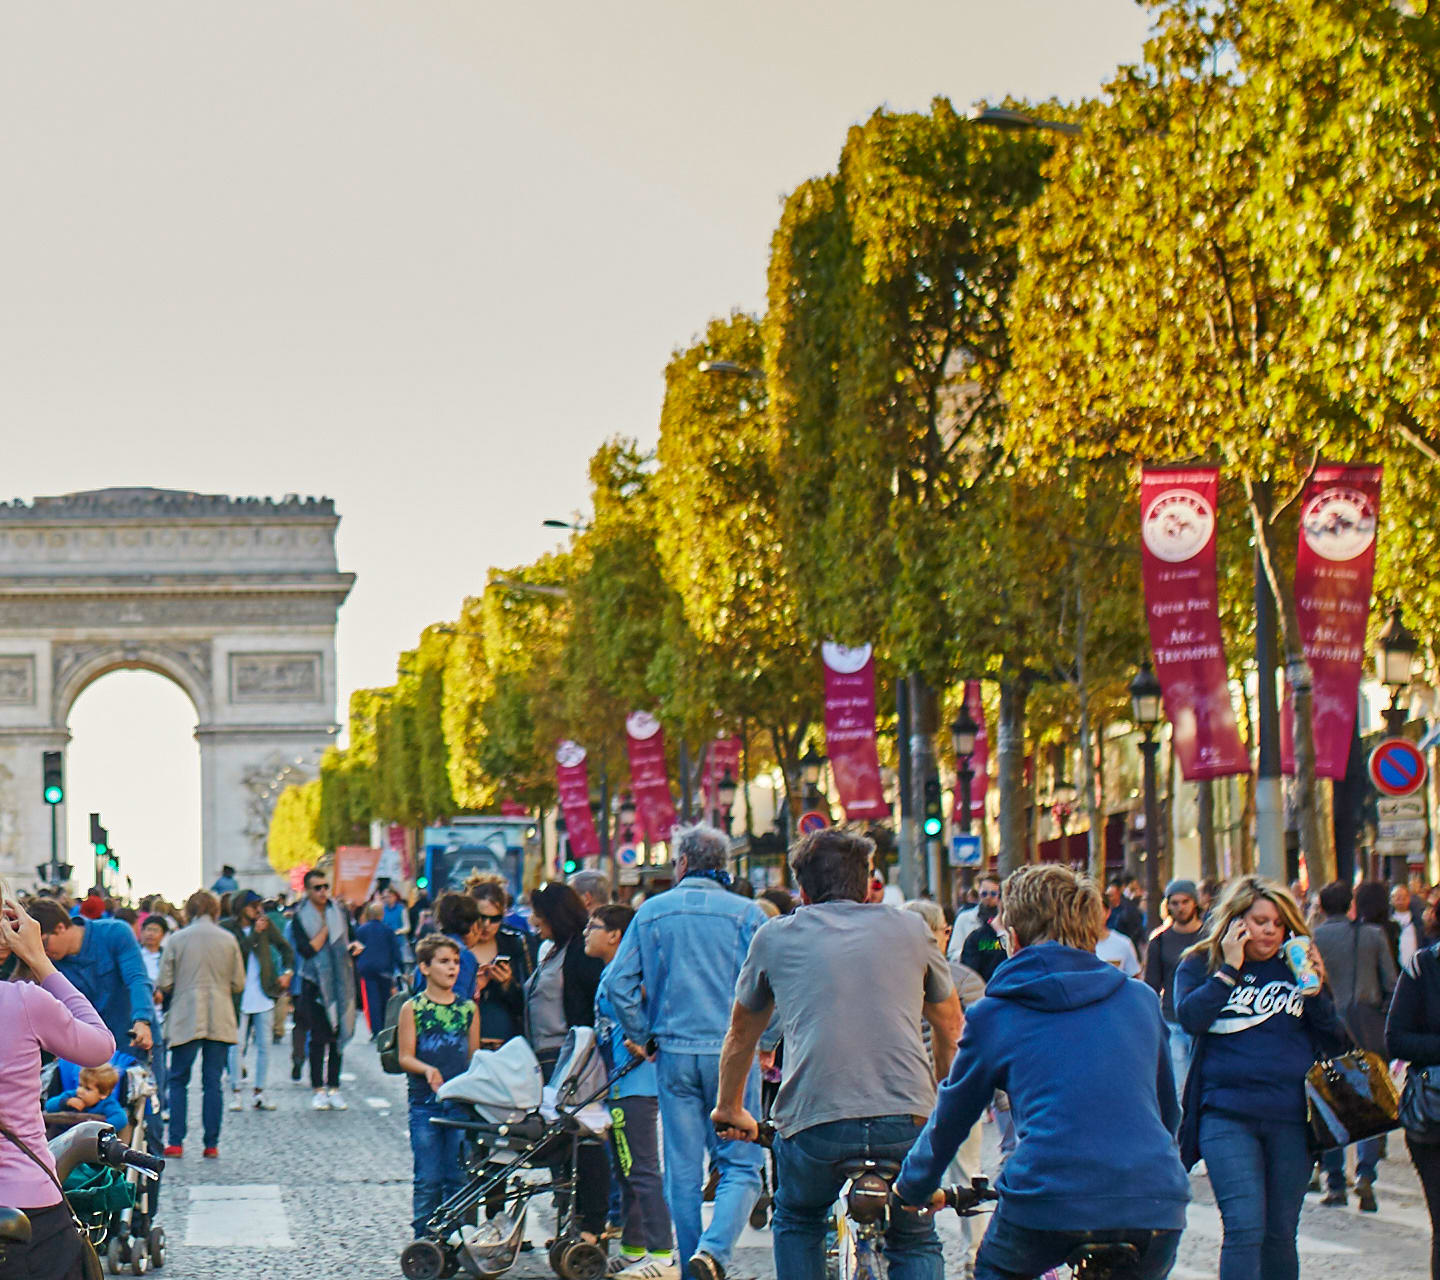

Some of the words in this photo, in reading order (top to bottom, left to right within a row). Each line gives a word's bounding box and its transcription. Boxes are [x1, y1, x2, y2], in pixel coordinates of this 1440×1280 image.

[1152, 601, 1186, 618] QATAR
[1187, 598, 1210, 613] PRIX
[1155, 644, 1221, 666] TRIOMPHE
